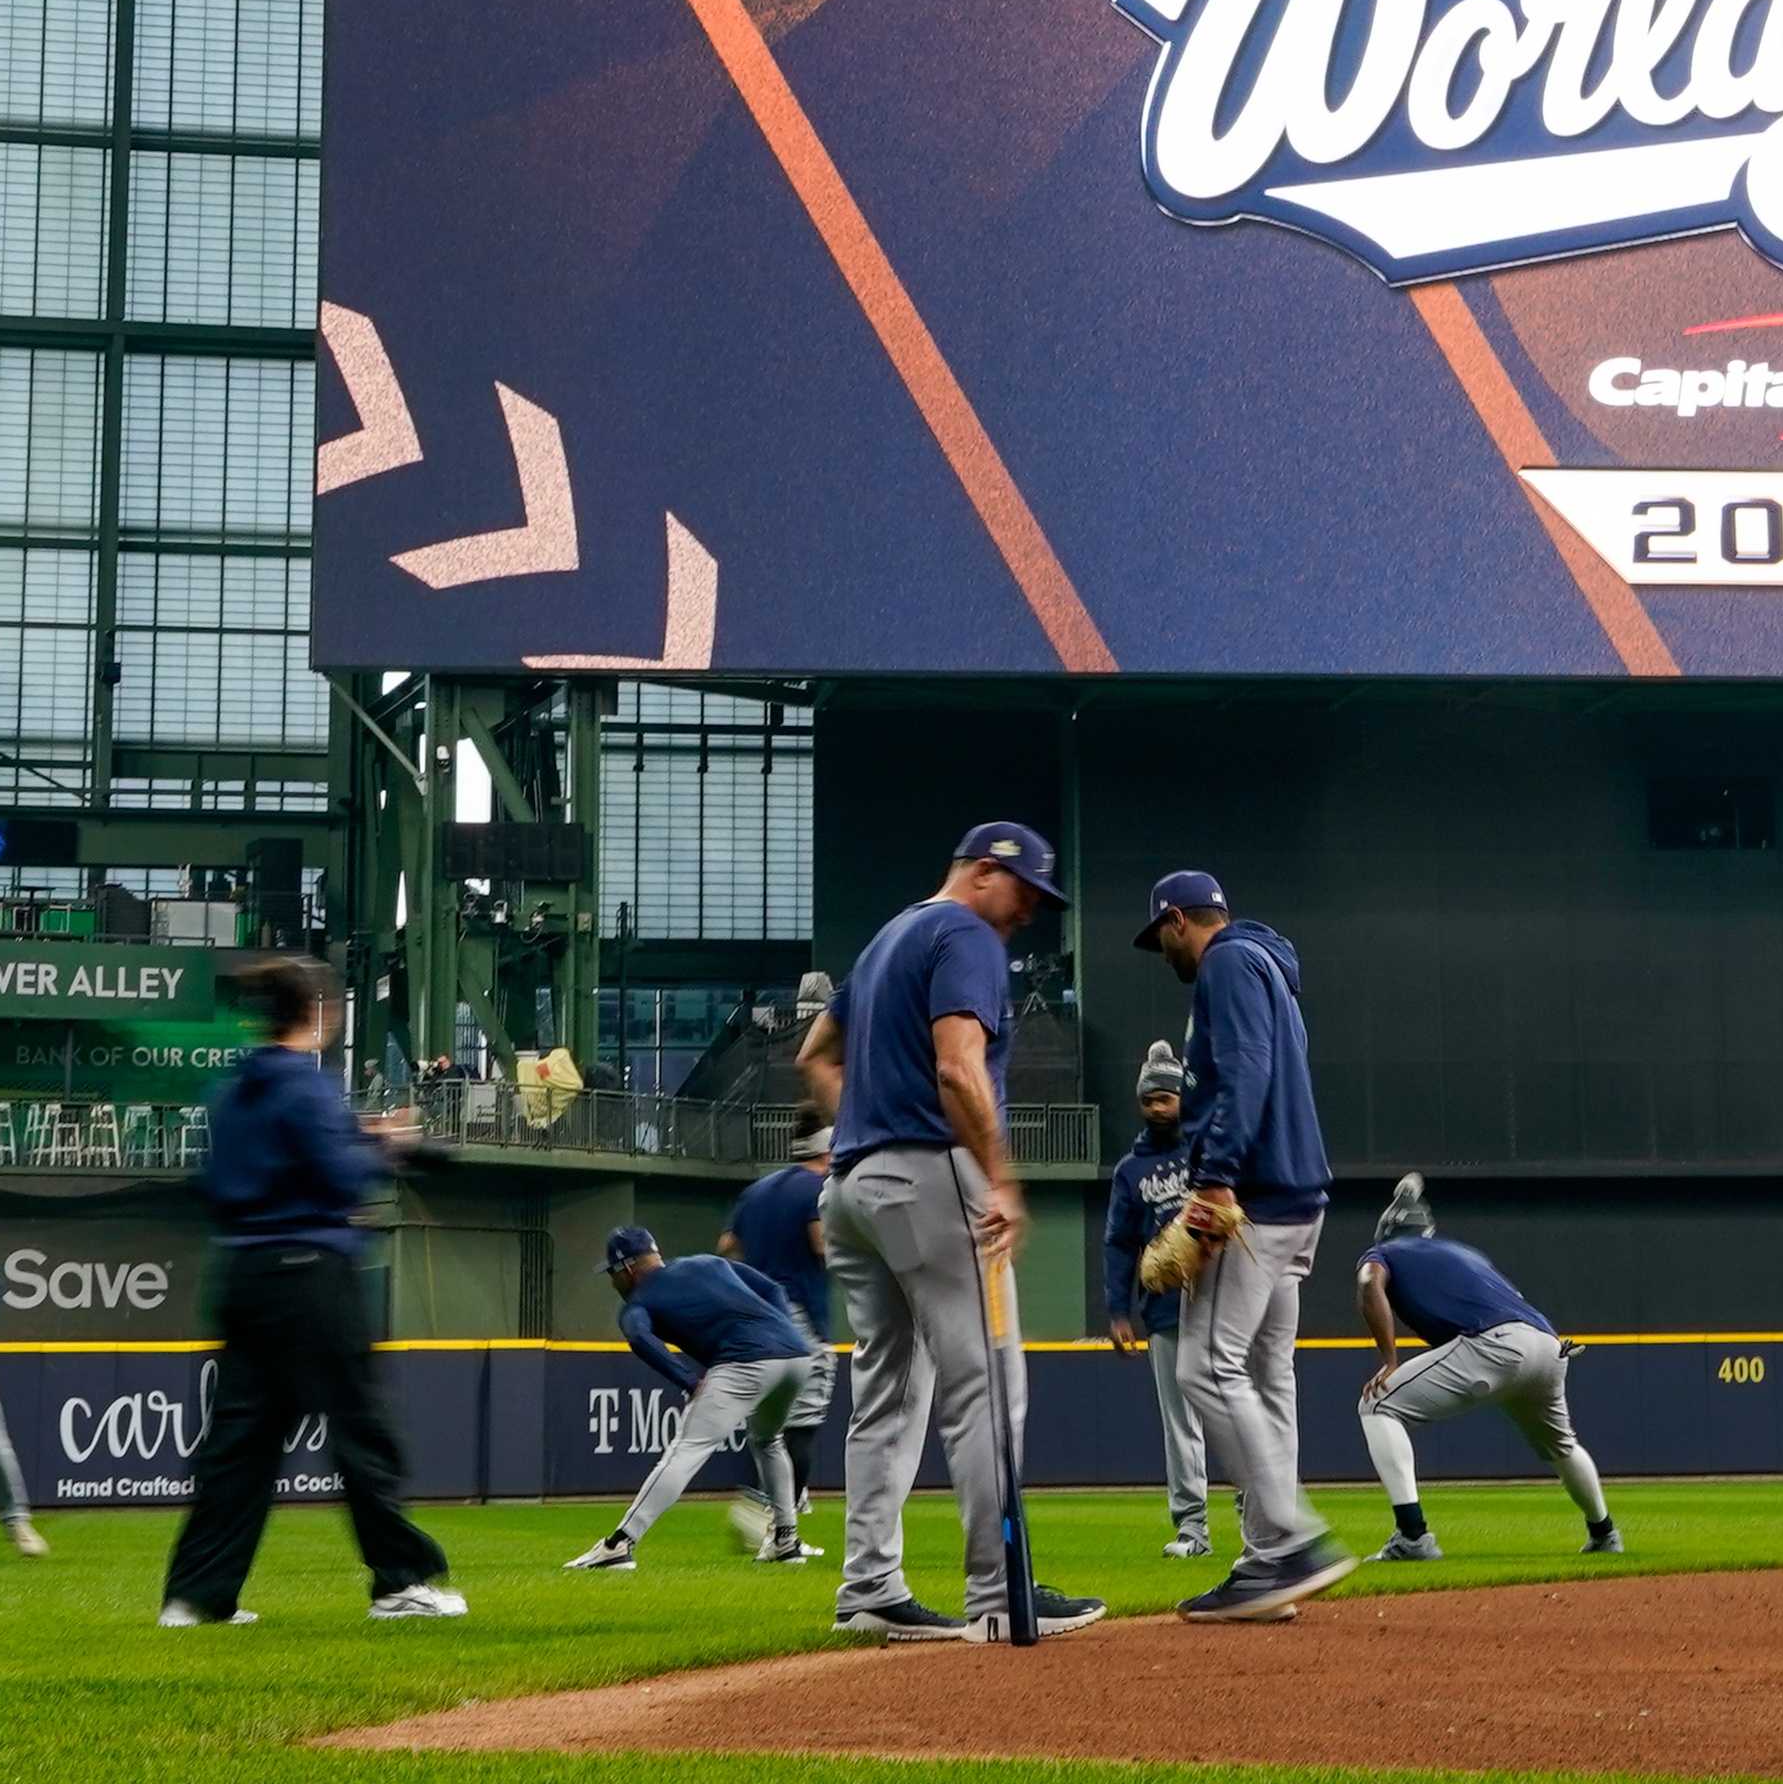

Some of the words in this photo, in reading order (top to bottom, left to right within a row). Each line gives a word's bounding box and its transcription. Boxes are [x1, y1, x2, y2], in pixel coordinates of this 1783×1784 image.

[67, 964, 186, 1002] ALLEY
[17, 1044, 82, 1067] BANK
[90, 1046, 123, 1068] OF
[132, 1046, 184, 1069] OUR
[2, 1248, 170, 1311] Save
[1717, 1356, 1766, 1384] 400
[628, 1389, 748, 1454] Moe
[57, 1476, 114, 1498] Hand
[116, 1474, 196, 1496] Crafted
